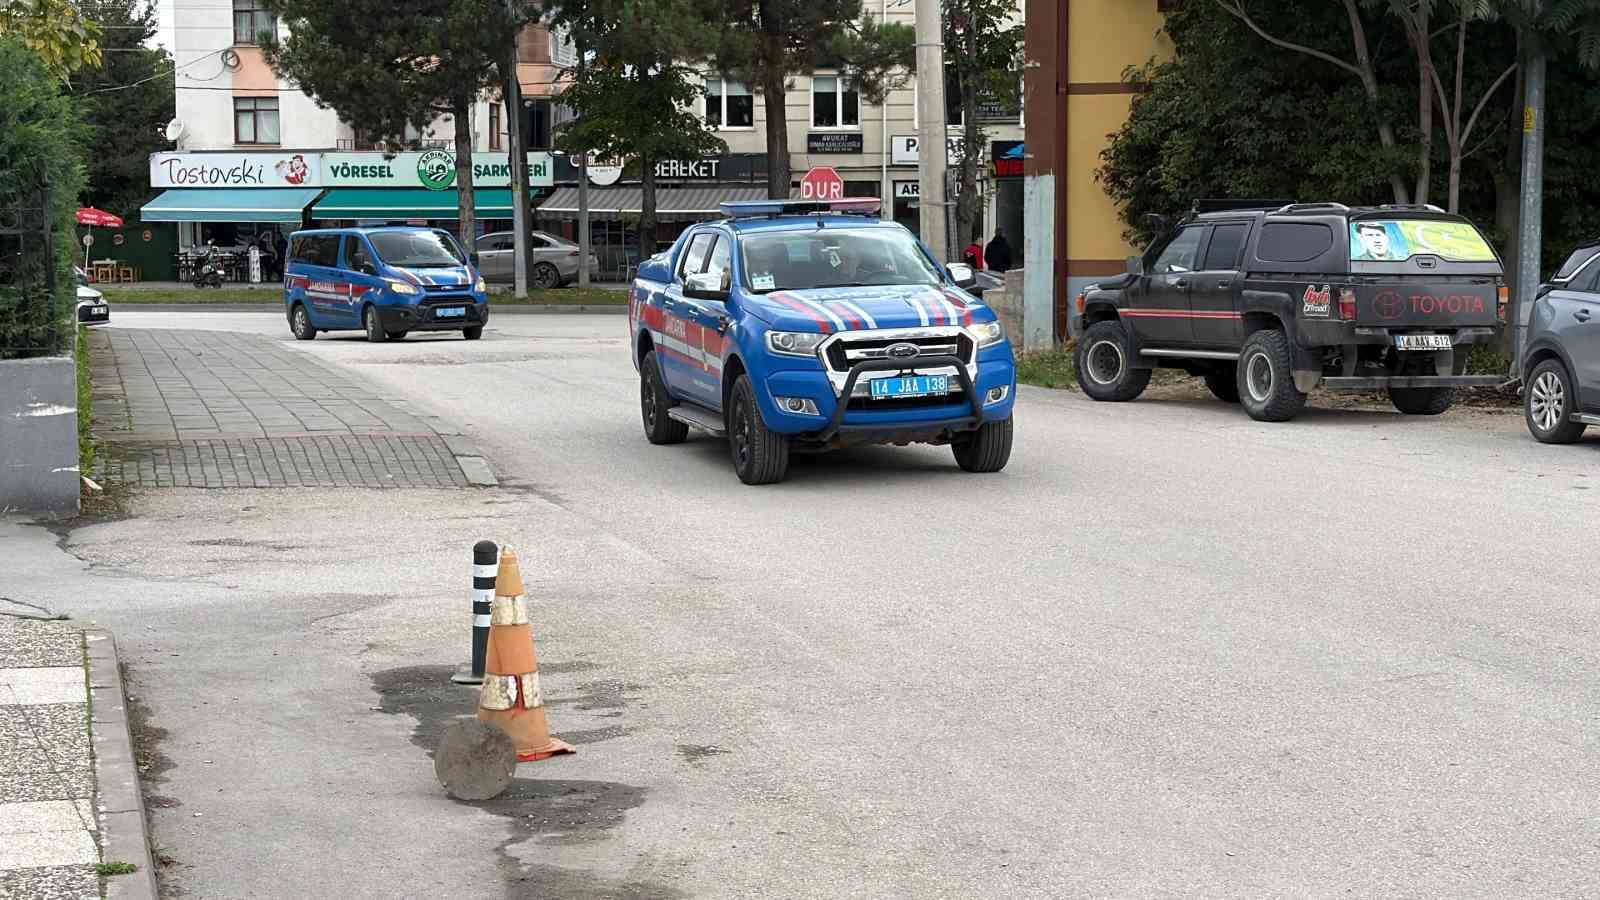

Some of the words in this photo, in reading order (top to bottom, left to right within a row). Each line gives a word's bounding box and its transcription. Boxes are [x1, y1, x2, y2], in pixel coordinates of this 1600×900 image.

[160, 157, 264, 184] Tostovski
[330, 162, 394, 178] YÖRESEL
[473, 160, 547, 179] ŞARKERİ
[655, 159, 720, 177] BEREKET
[803, 182, 841, 199] DUR
[1409, 296, 1484, 313] TOYOTA
[874, 380, 889, 395] 14
[898, 378, 919, 394] JAA
[926, 376, 945, 391] 138
